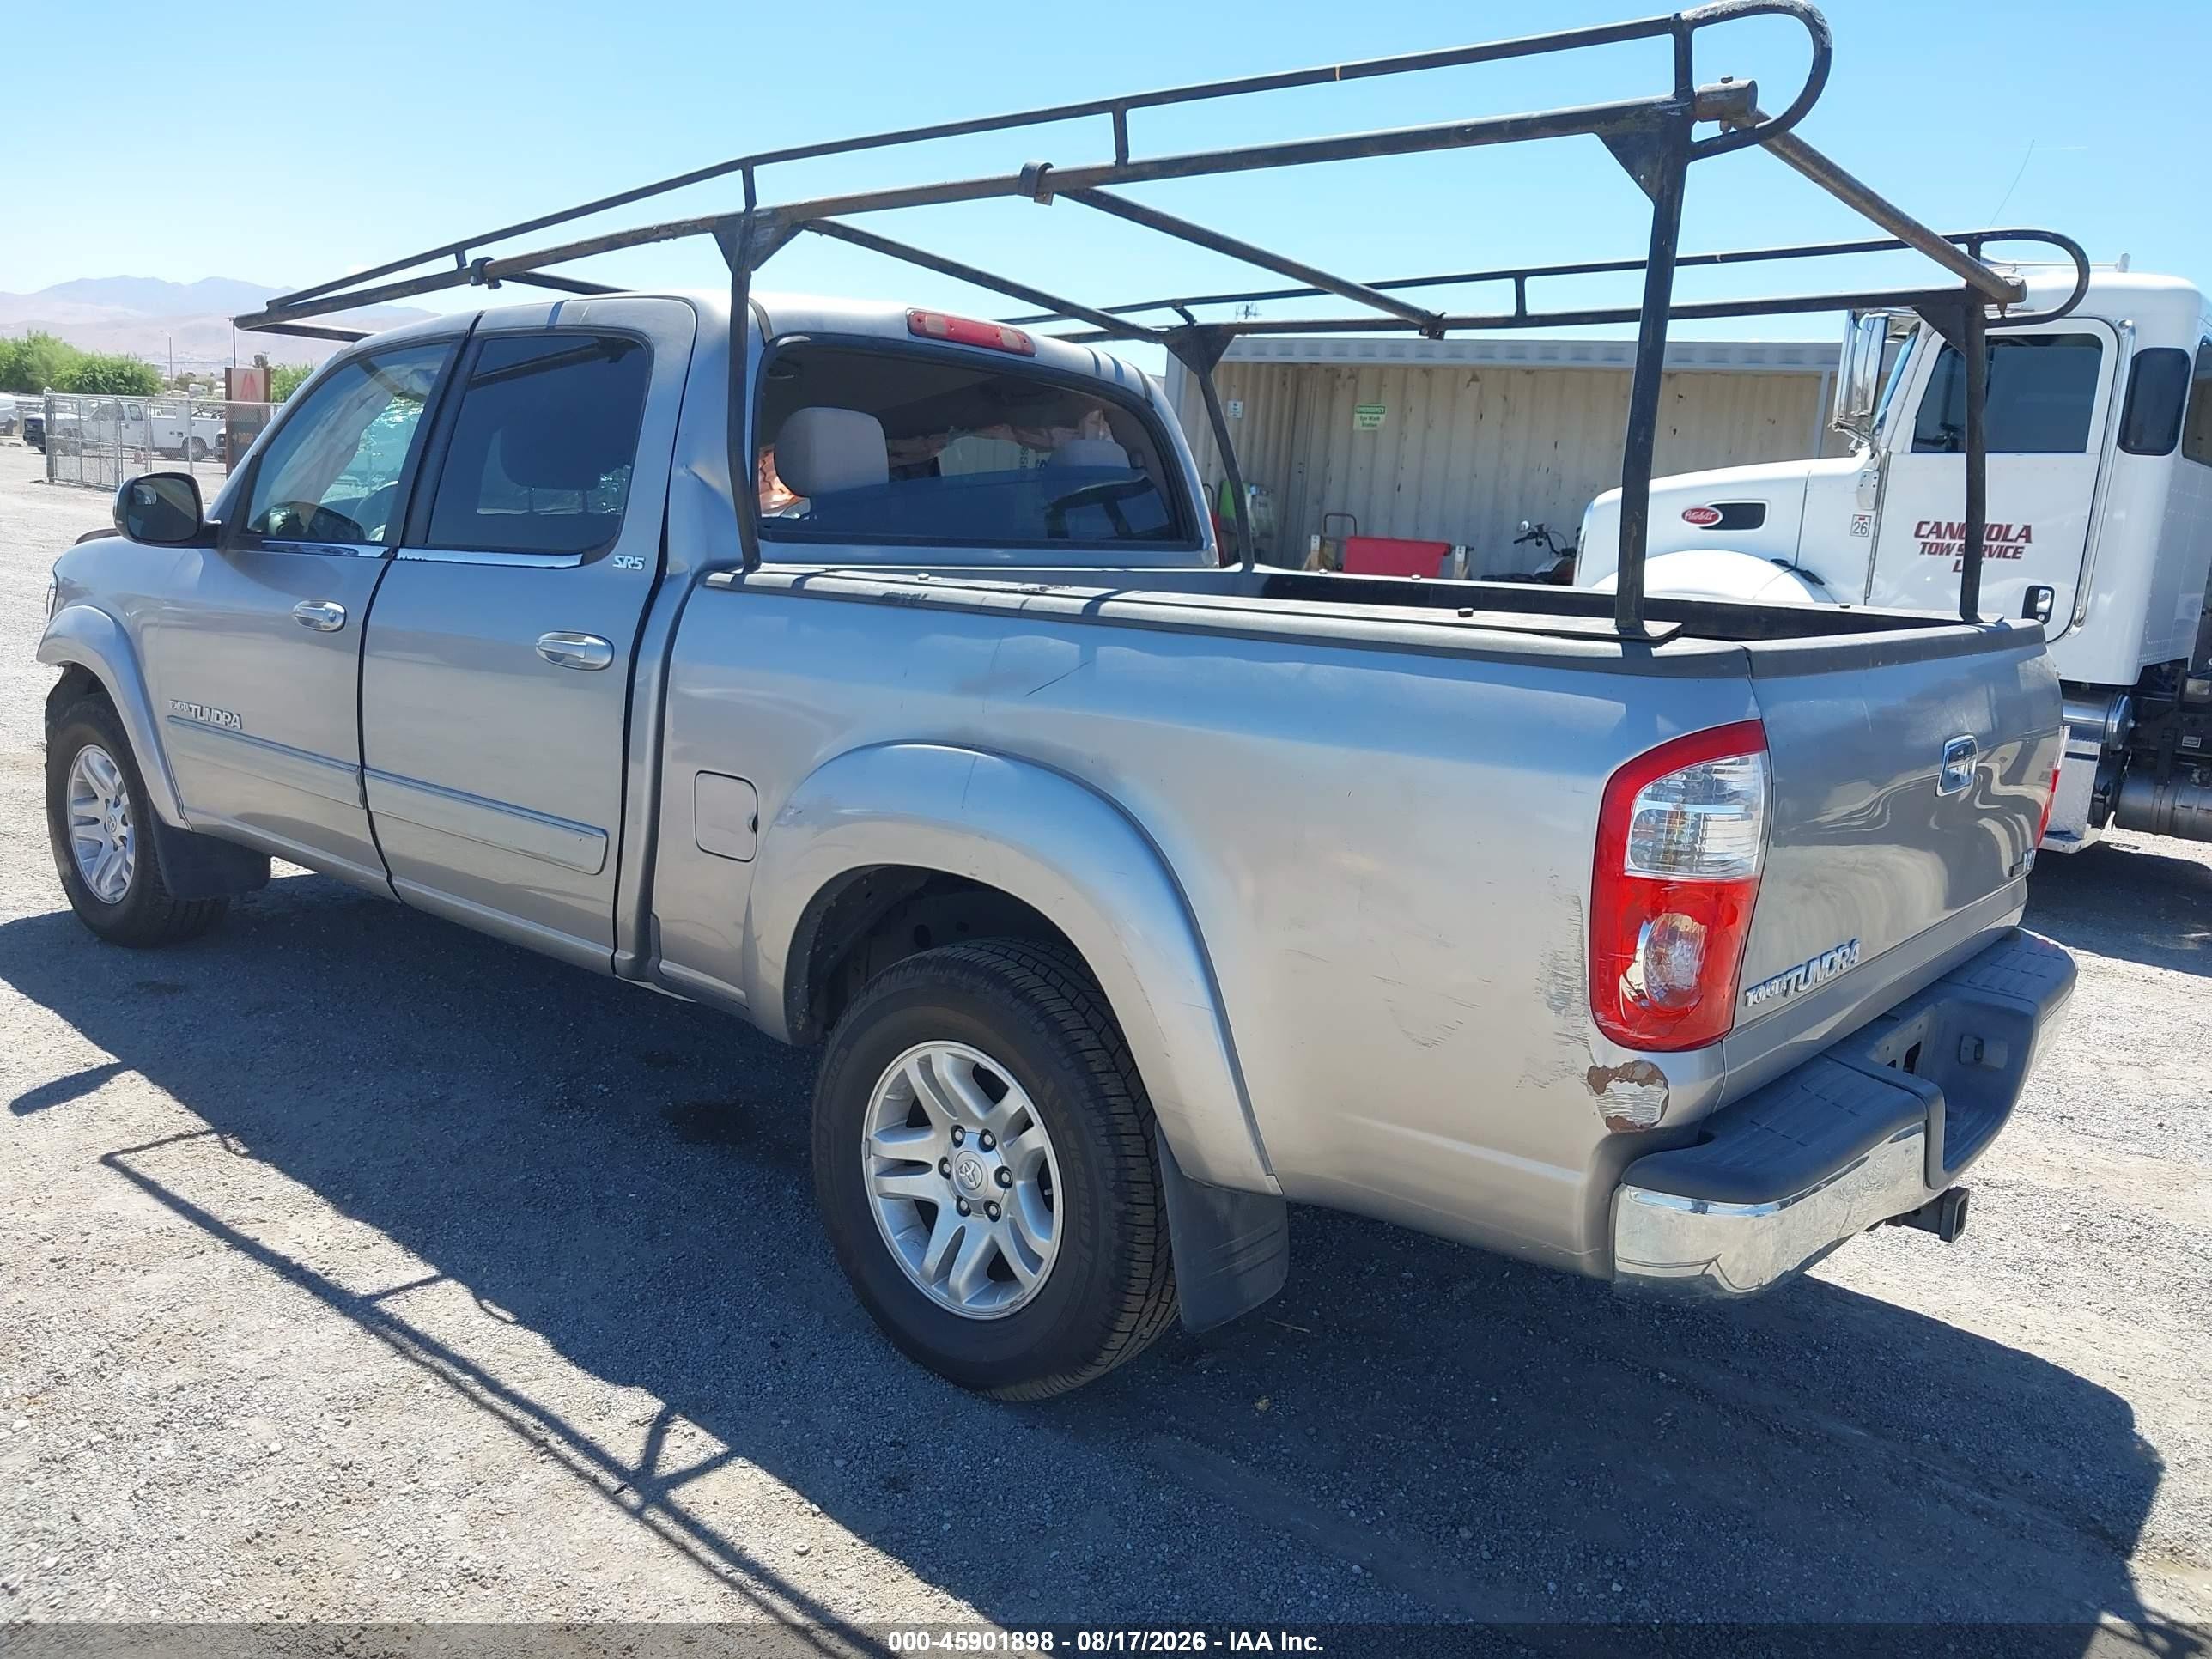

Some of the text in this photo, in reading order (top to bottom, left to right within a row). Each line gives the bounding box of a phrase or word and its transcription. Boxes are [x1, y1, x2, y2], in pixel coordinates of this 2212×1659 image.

[1853, 521, 1868, 536] 26
[1919, 541, 2025, 560] TOW SRVICE
[612, 555, 645, 570] SR5
[189, 704, 242, 730] TUNDRA
[1746, 938, 1861, 1007] TOYOTA TUNDRA
